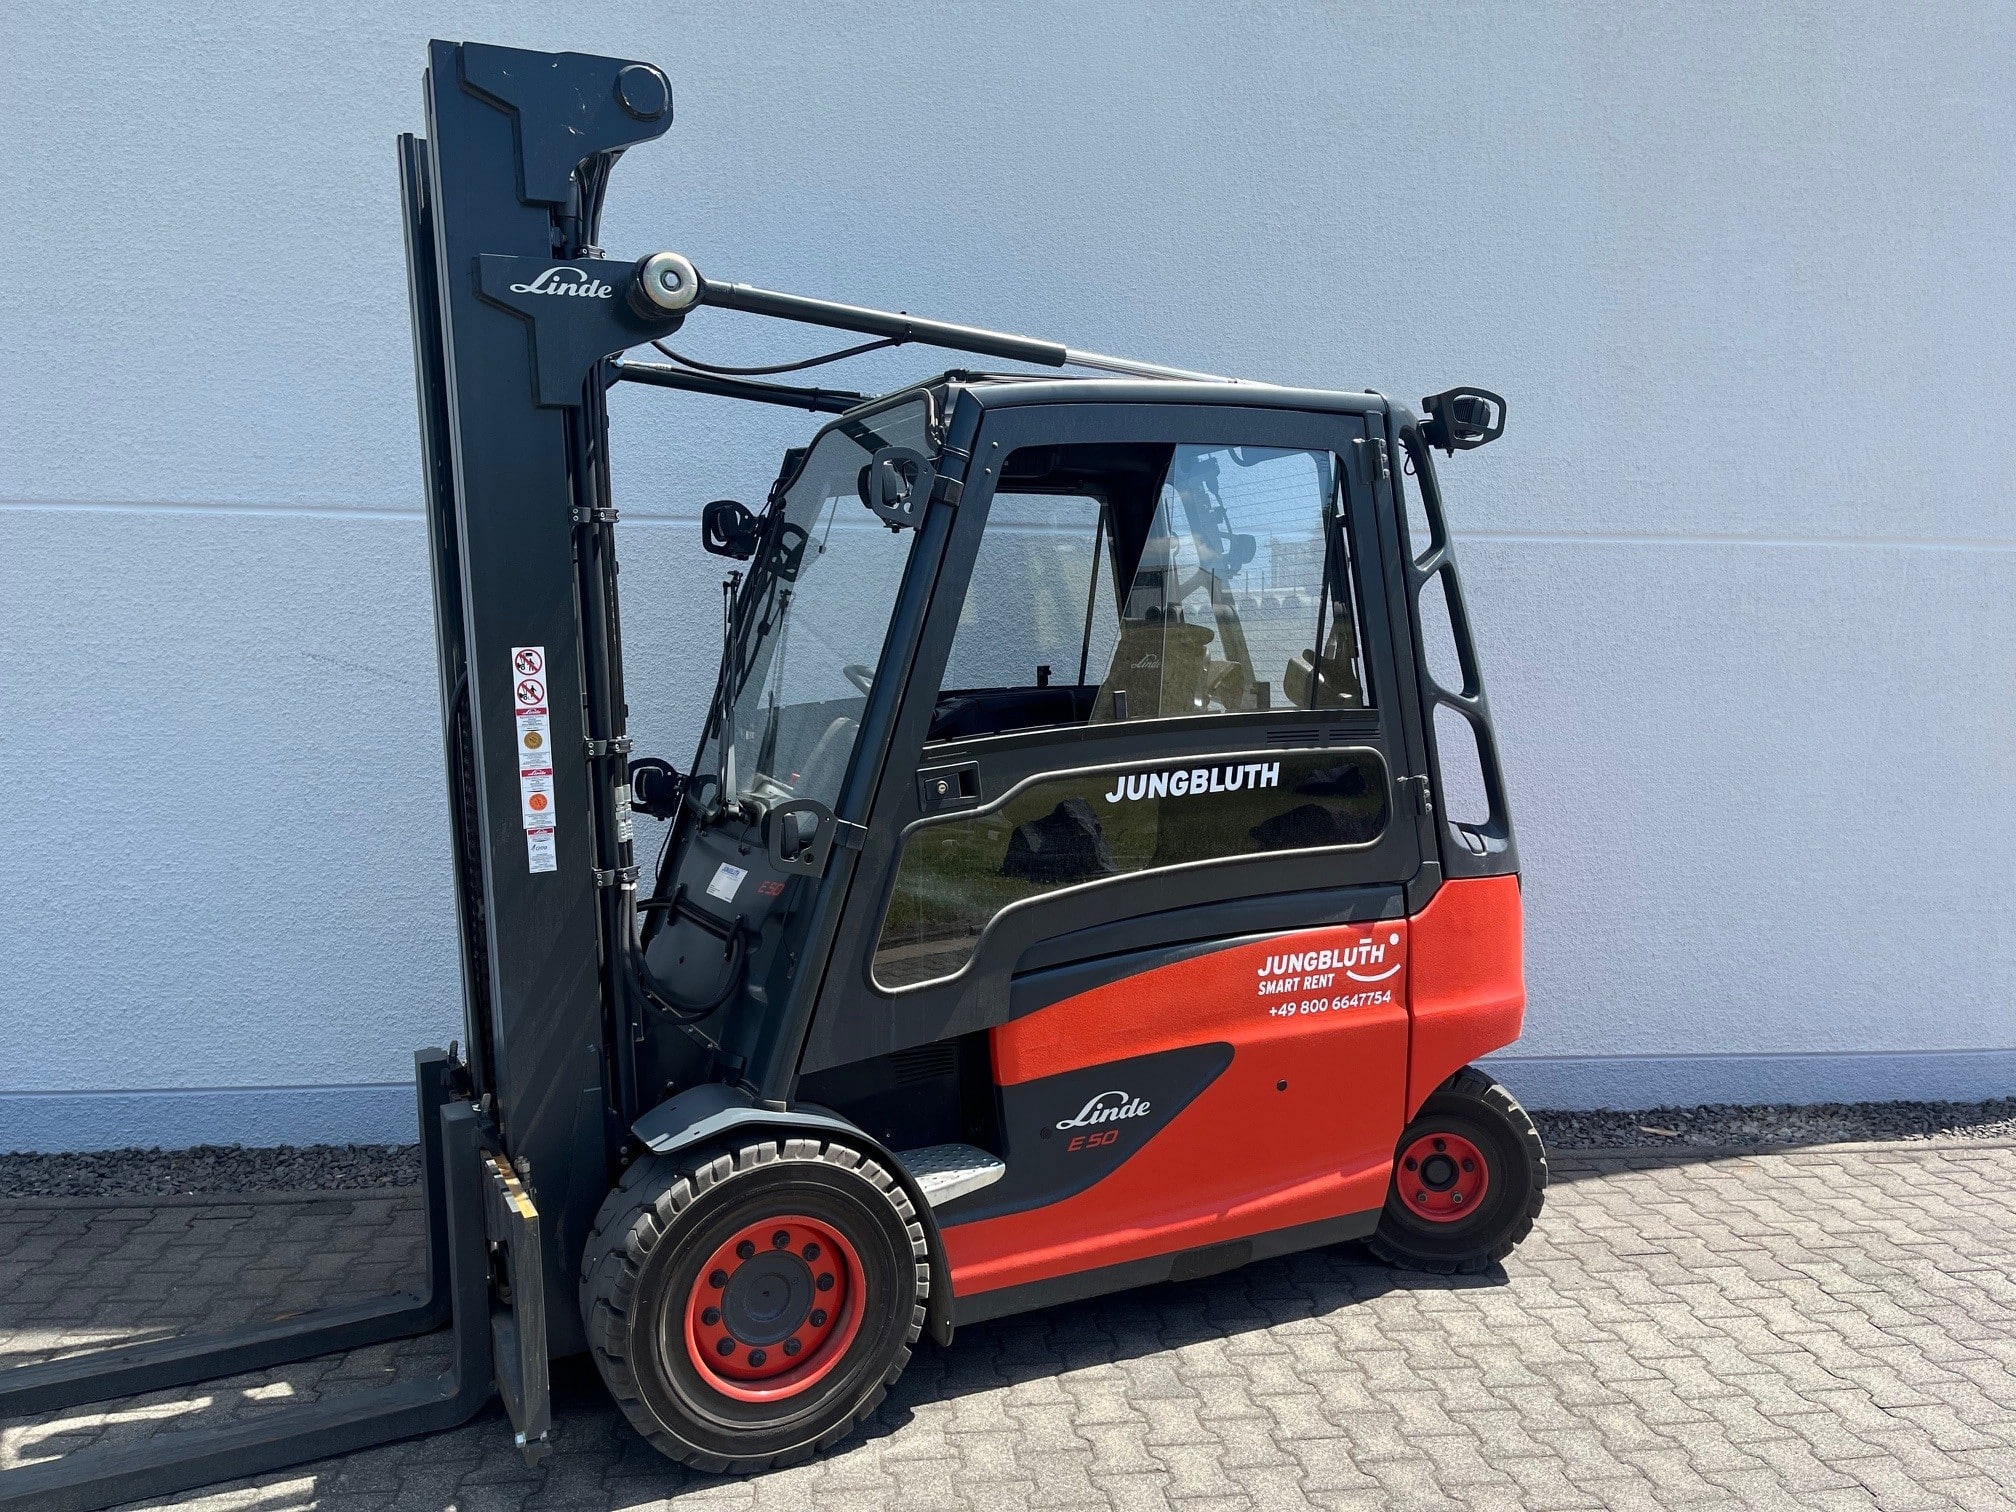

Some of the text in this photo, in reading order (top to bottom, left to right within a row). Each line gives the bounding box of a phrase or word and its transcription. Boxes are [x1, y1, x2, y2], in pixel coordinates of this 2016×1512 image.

[509, 266, 613, 299] Linde
[1105, 761, 1280, 803] JUNGBLUTH
[1258, 973, 1336, 996] SMART RENT
[1269, 990, 1392, 1017] +49 800 6647754
[1056, 1090, 1151, 1130] Linde
